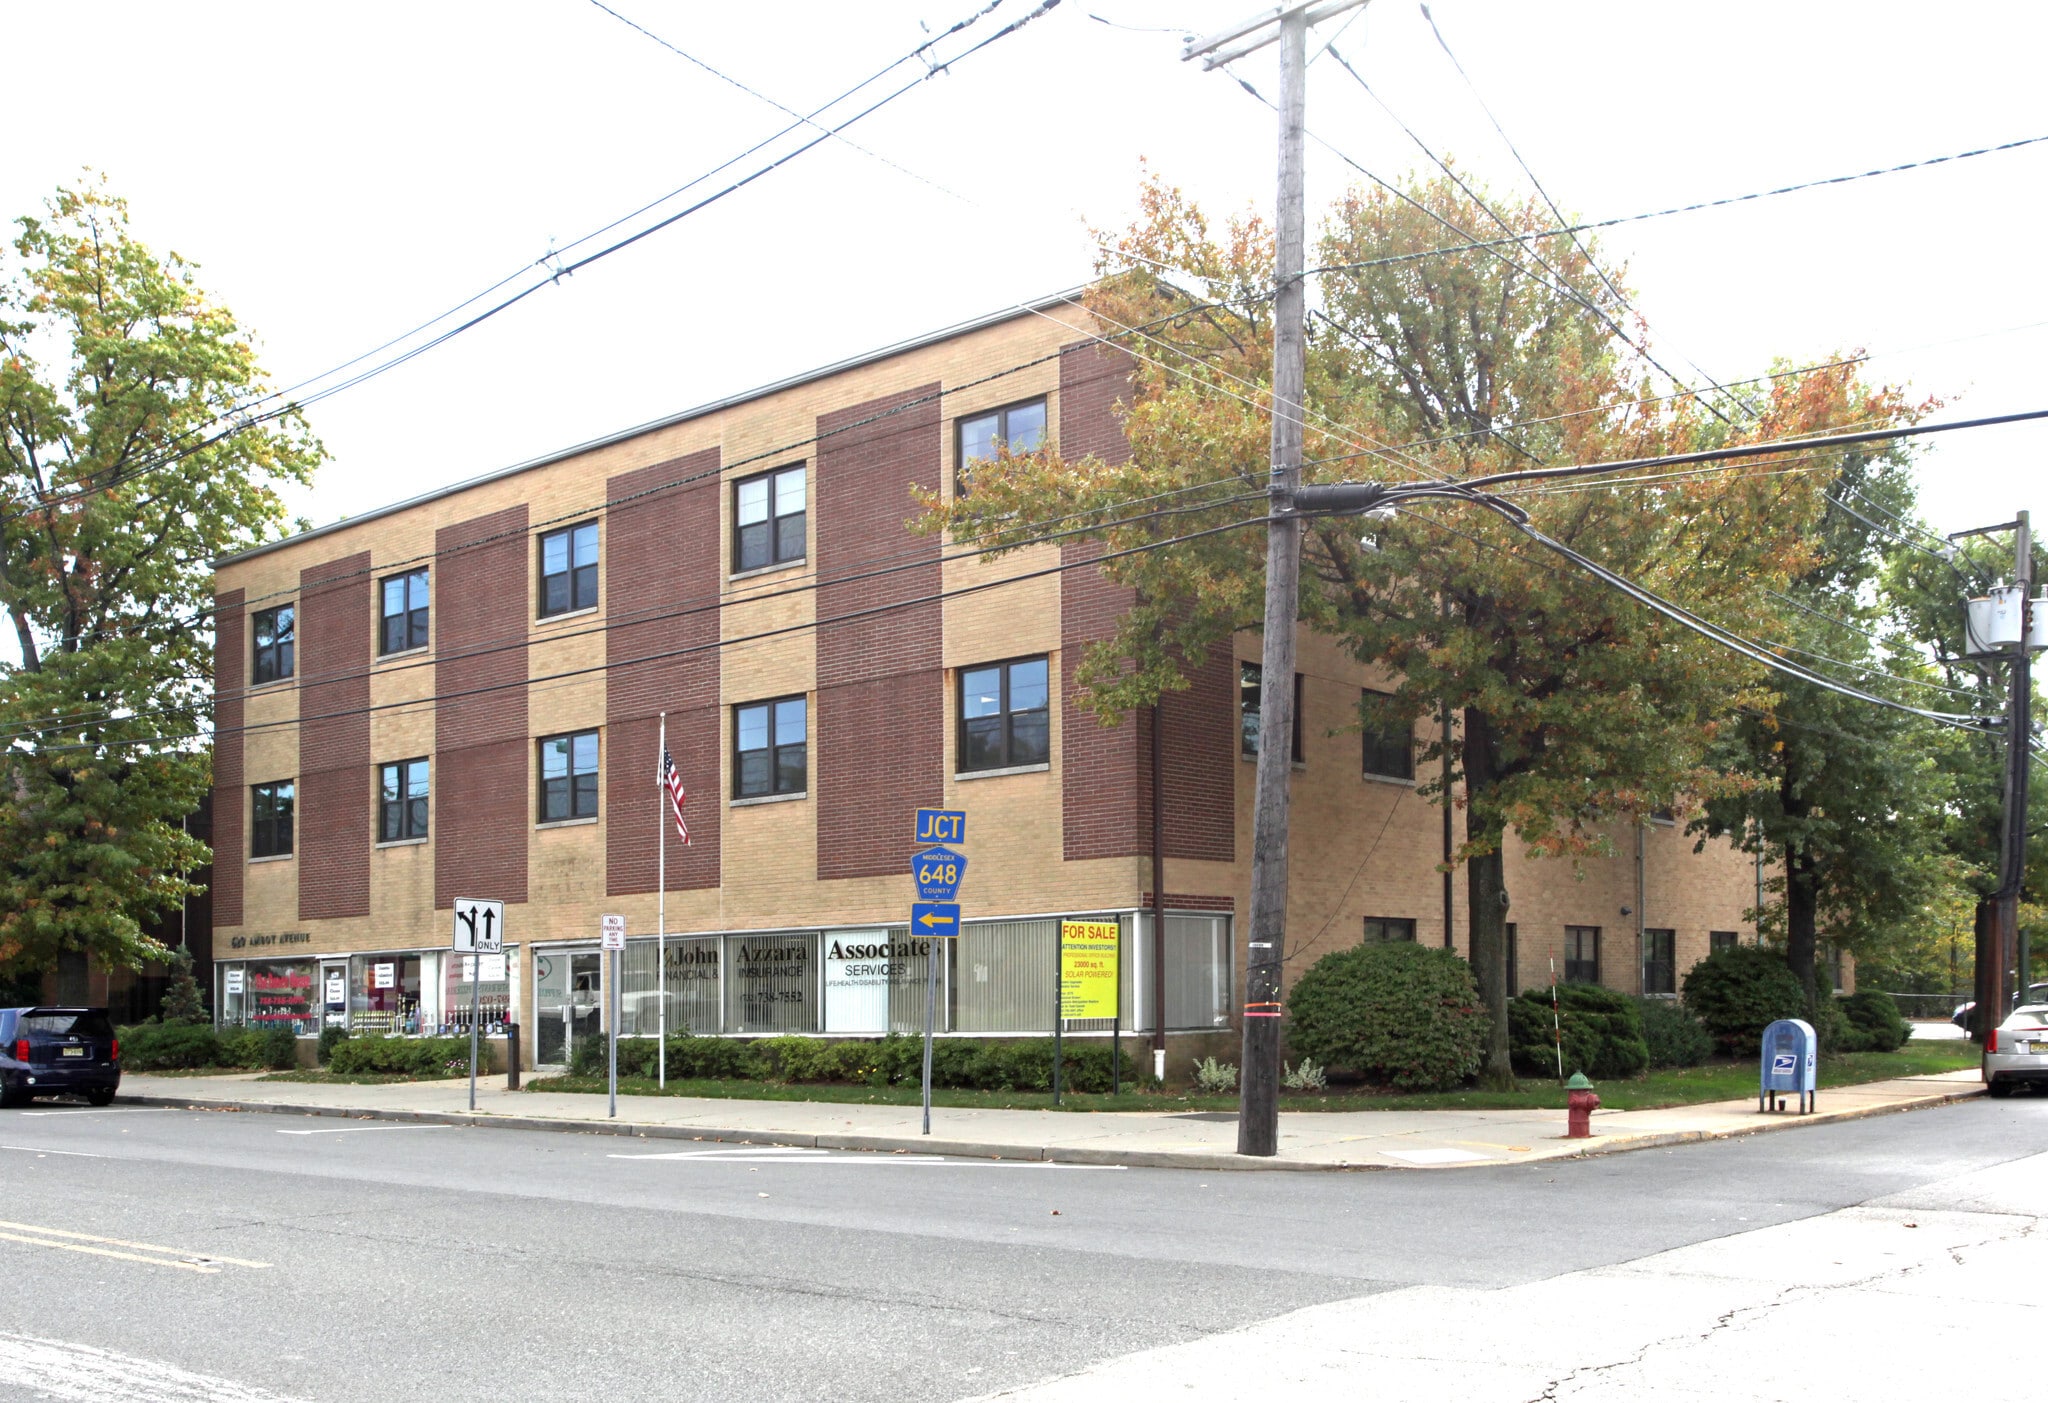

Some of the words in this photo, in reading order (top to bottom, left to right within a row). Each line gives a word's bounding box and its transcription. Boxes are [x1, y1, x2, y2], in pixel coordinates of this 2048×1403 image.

[920, 815, 962, 839] JCT
[919, 864, 957, 885] 648
[608, 917, 619, 925] NO
[280, 932, 311, 944] AVENUE
[1063, 925, 1085, 939] FOR
[1088, 926, 1116, 940] SALE
[477, 940, 500, 950] ONLY
[674, 946, 719, 966] John
[736, 944, 807, 963] Azzara
[738, 965, 804, 978] INSURANCE
[845, 963, 907, 976] SERVICES
